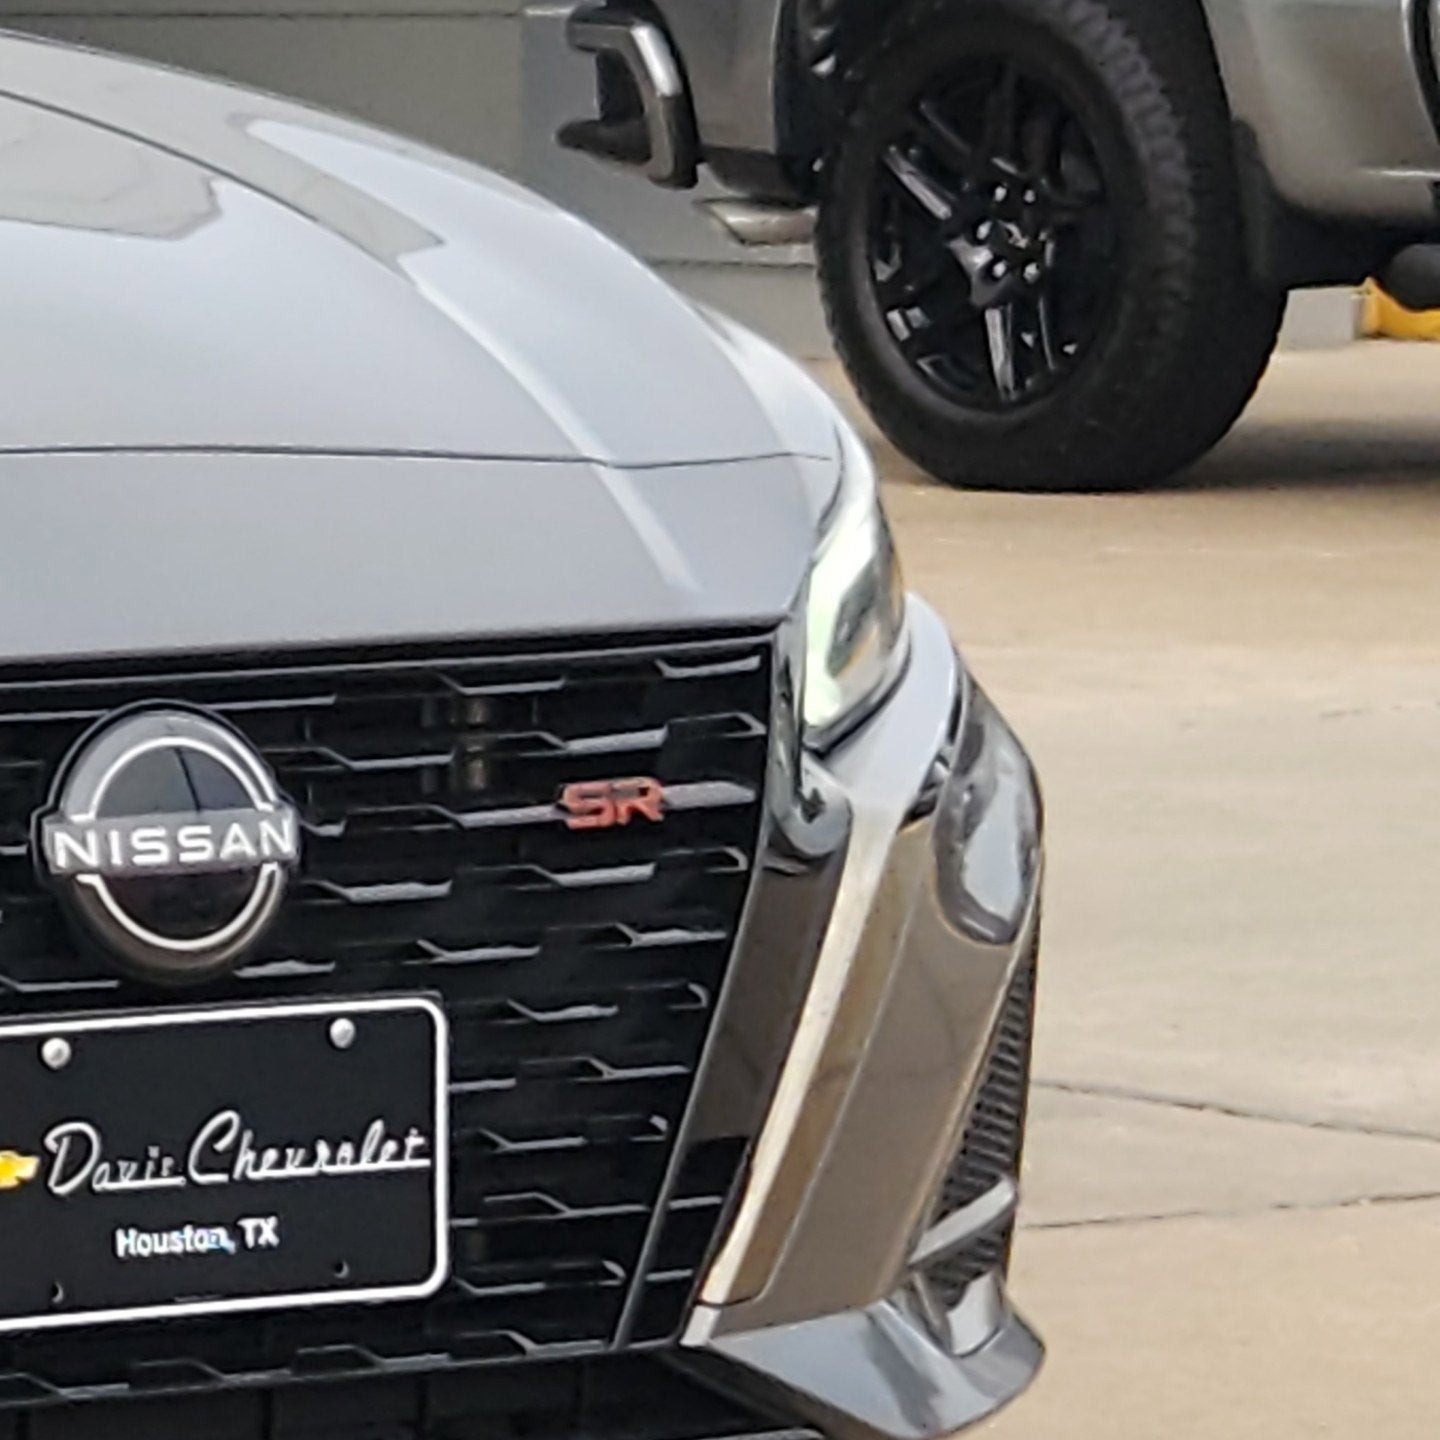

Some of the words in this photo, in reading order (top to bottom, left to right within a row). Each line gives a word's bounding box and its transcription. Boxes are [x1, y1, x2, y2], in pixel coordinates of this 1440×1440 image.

[560, 774, 665, 830] SR
[52, 818, 297, 869] NISSAN
[43, 1120, 186, 1196] Davis
[187, 1108, 433, 1185] Chevrolet
[114, 1222, 235, 1259] Houston,
[237, 1215, 280, 1249] TX
